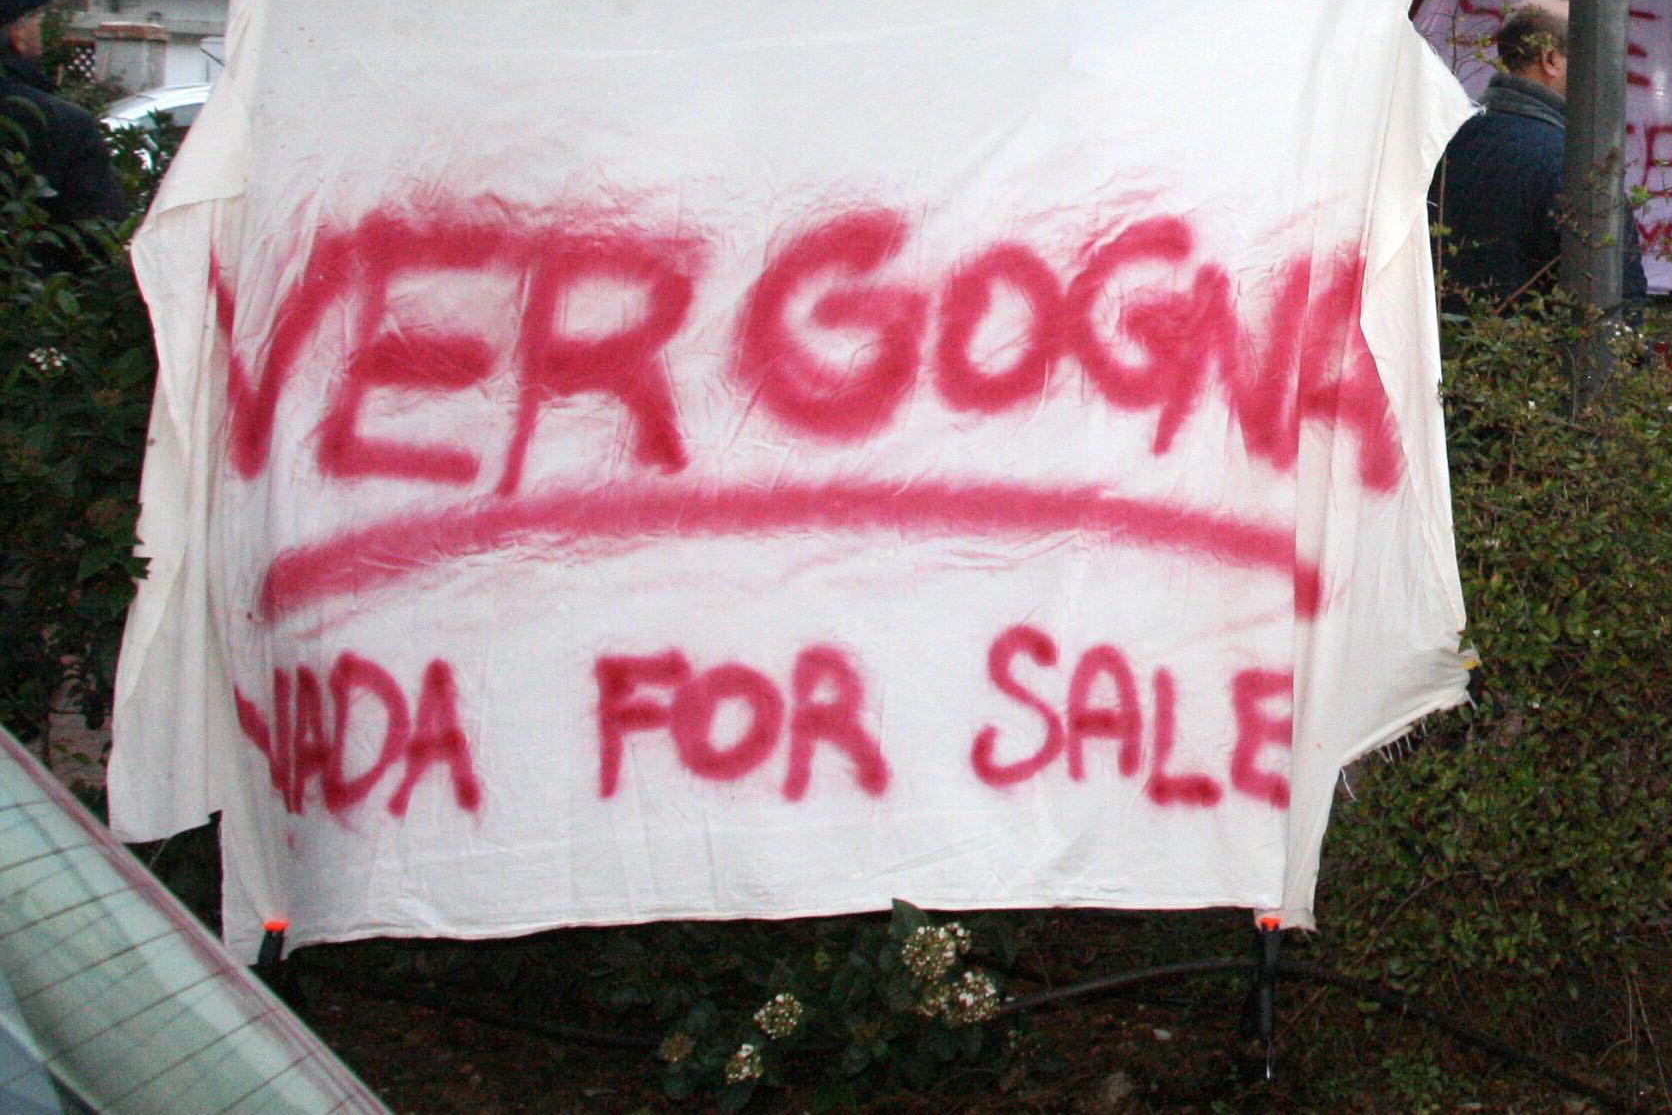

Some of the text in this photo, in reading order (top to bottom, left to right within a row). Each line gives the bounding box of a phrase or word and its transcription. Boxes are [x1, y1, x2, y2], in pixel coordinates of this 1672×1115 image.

[208, 201, 1403, 498] VERGOGNA
[593, 643, 892, 803] FOR
[969, 623, 1293, 811] SALE
